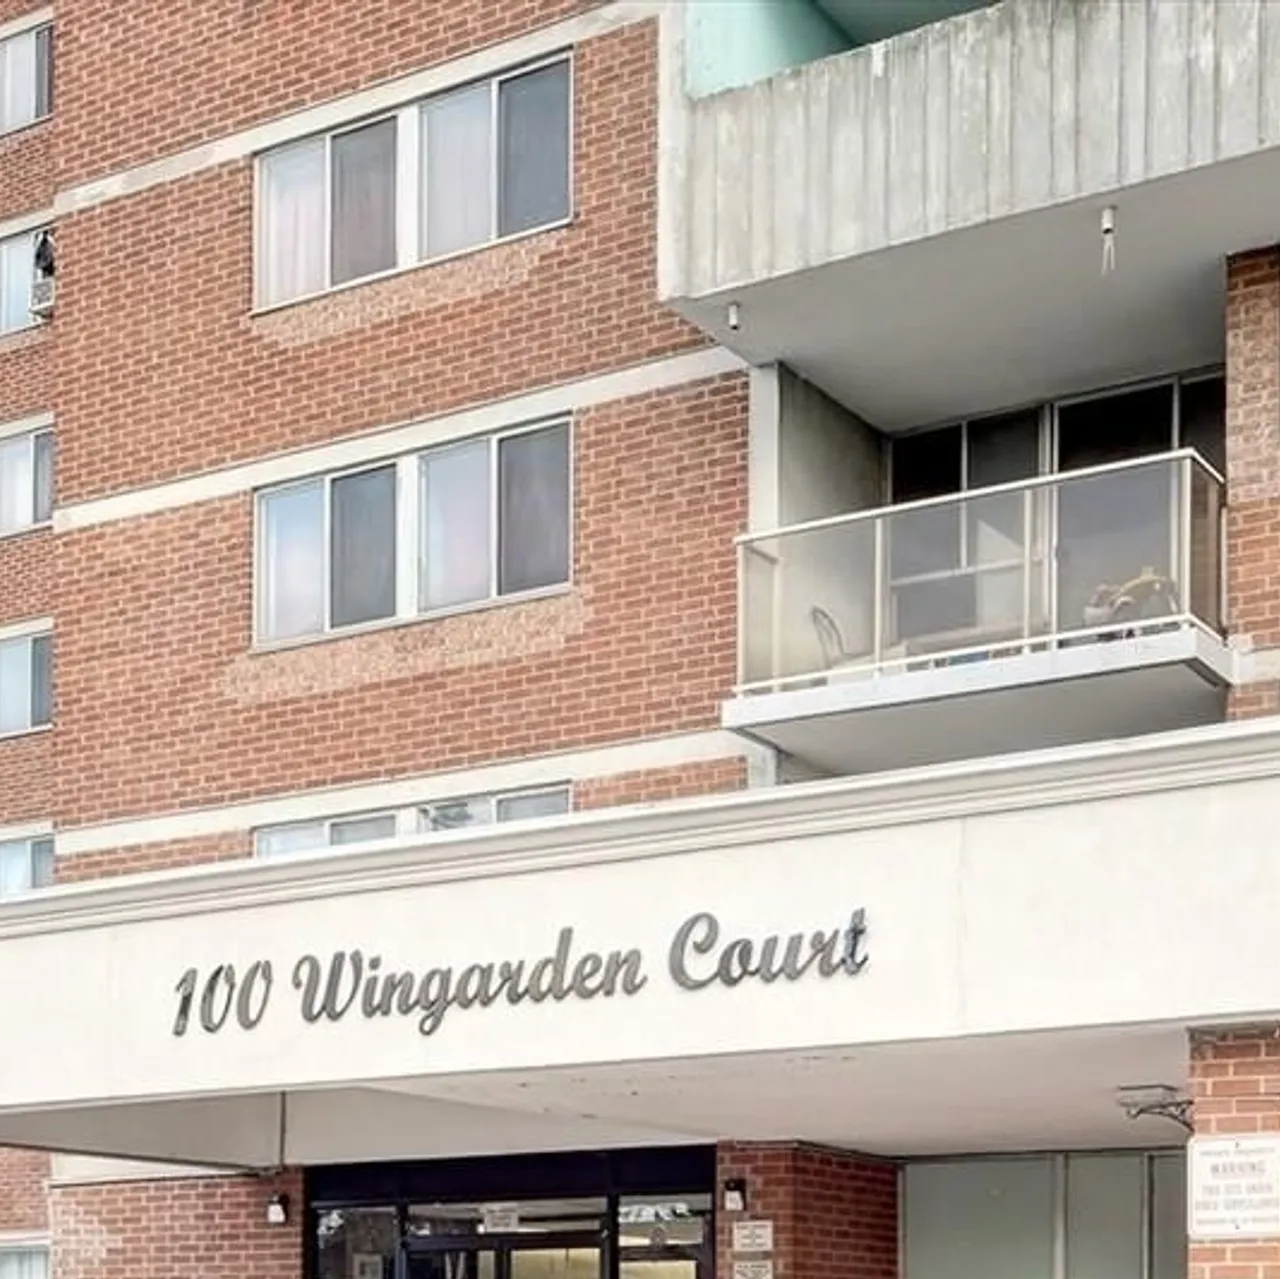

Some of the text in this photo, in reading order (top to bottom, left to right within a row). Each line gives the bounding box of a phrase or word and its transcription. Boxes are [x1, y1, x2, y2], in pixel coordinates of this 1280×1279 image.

[173, 907, 869, 1037] 100 Wingarden Court
